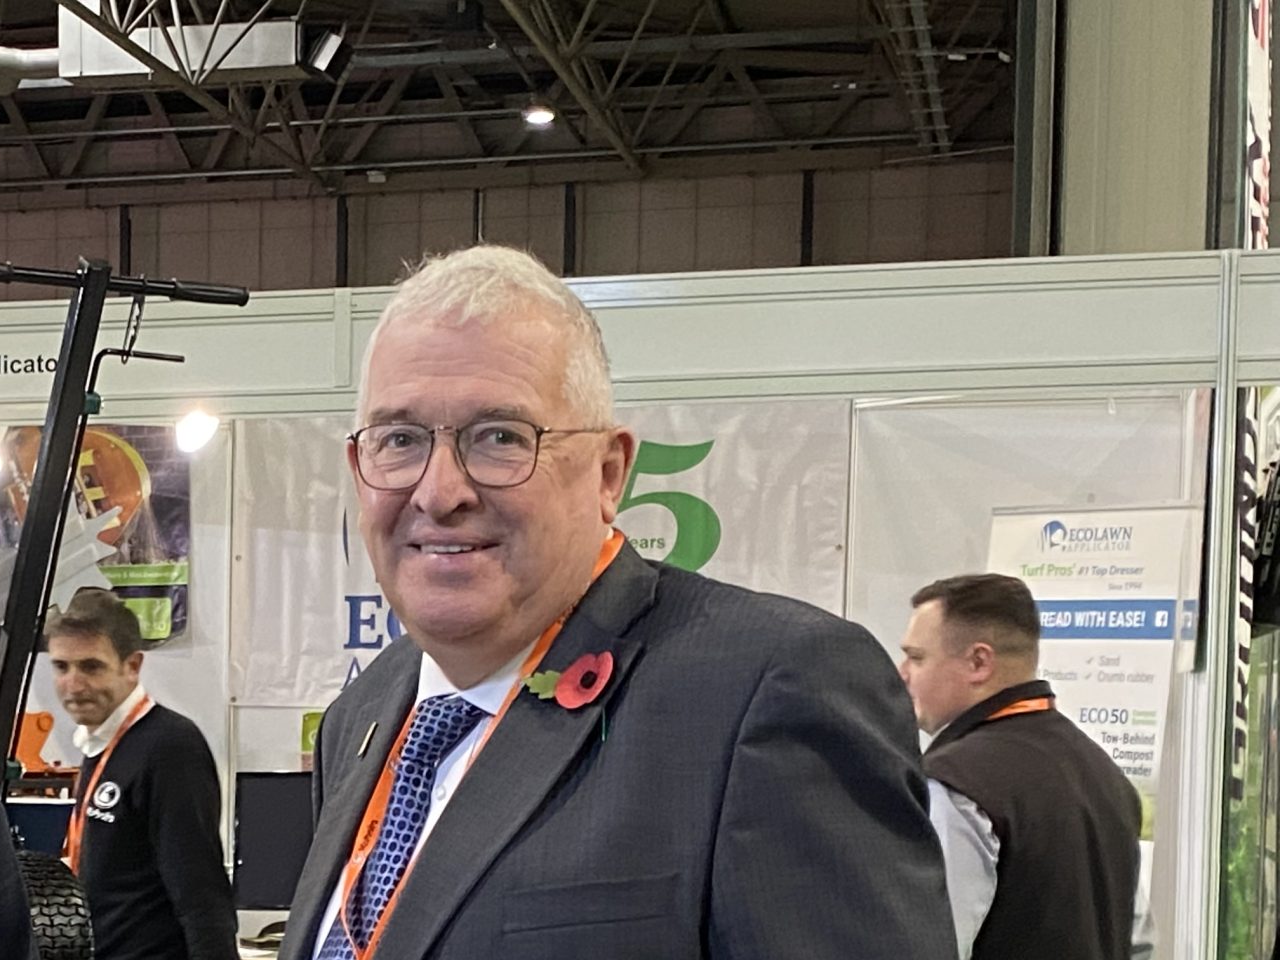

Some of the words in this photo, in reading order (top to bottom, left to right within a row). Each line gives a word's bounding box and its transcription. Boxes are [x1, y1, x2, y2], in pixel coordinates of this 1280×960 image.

[1068, 527, 1133, 543] ECOLAWN
[628, 536, 666, 550] ears
[1021, 564, 1045, 577] Turf
[1092, 566, 1107, 577] Top
[1109, 565, 1144, 577] Dresser
[1040, 612, 1071, 627] READ
[1074, 611, 1105, 628] WITH
[1108, 610, 1146, 627] EASE!
[1102, 731, 1155, 746] Tow-Behind
[1112, 748, 1154, 762] Compost
[1122, 767, 1152, 777] reader
